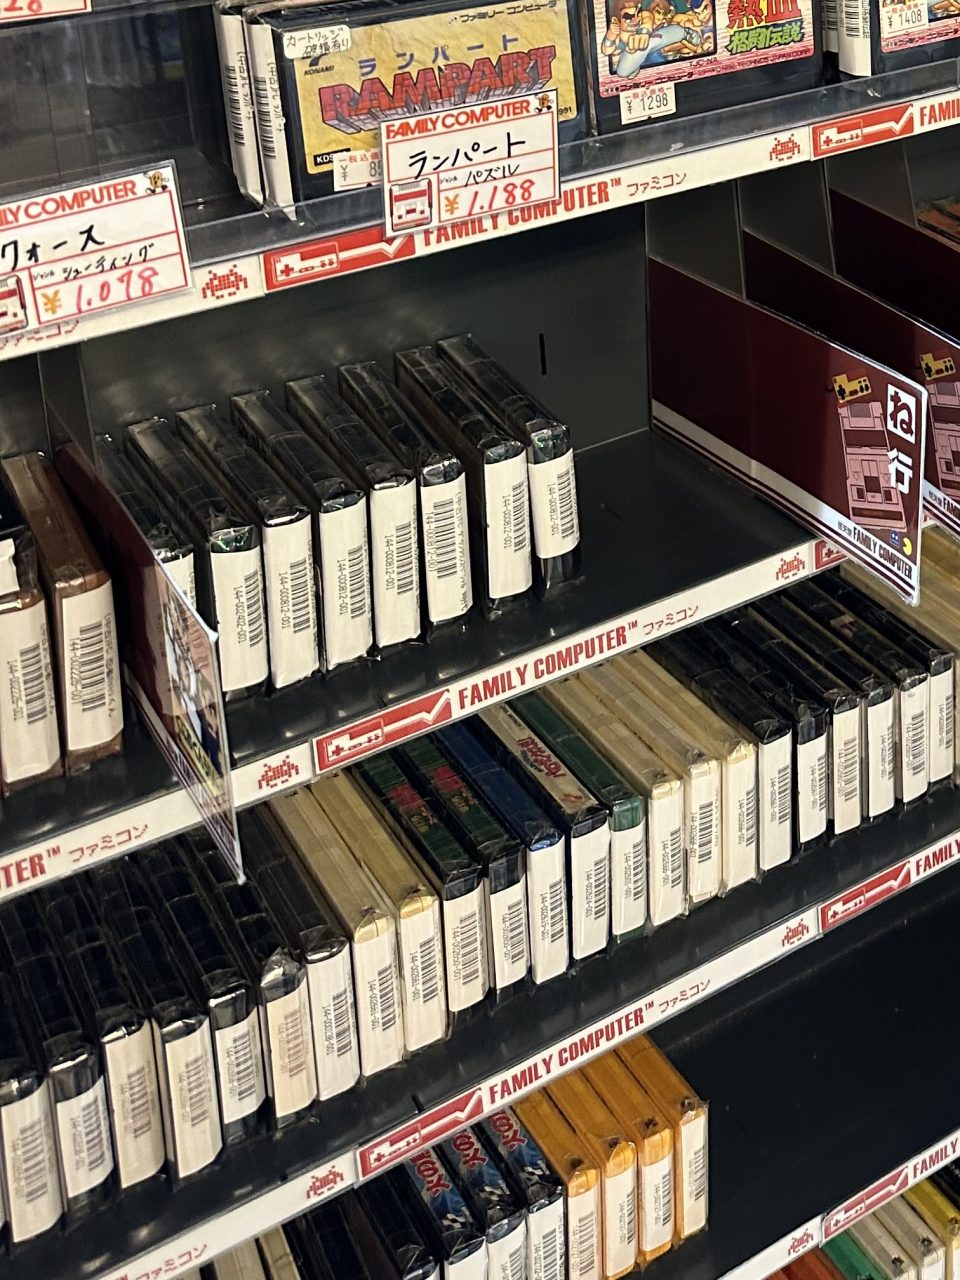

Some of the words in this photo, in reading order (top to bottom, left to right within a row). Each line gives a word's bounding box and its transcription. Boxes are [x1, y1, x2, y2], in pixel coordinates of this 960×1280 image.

[287, 27, 345, 47] カートリッジ
[727, 20, 804, 55] 格闘伝説
[899, 9, 923, 27] 1408
[359, 34, 518, 76] ランパート
[319, 45, 556, 134] RAMPART
[640, 93, 668, 112] 1298
[386, 116, 439, 140] FAMILY
[442, 100, 531, 129] COMPUTER
[409, 132, 525, 179] ランパート
[464, 163, 520, 187] パズル
[25, 180, 136, 219] COMPUTER
[627, 165, 697, 196] ファミコン
[887, 389, 914, 494] ね行
[458, 663, 528, 710] FAMILY
[643, 605, 699, 635] ファミコン
[69, 823, 148, 862] ファミコン
[489, 1055, 553, 1105] FAMILY
[659, 980, 710, 1013] ファミコン
[913, 1139, 958, 1179] FAMILY
